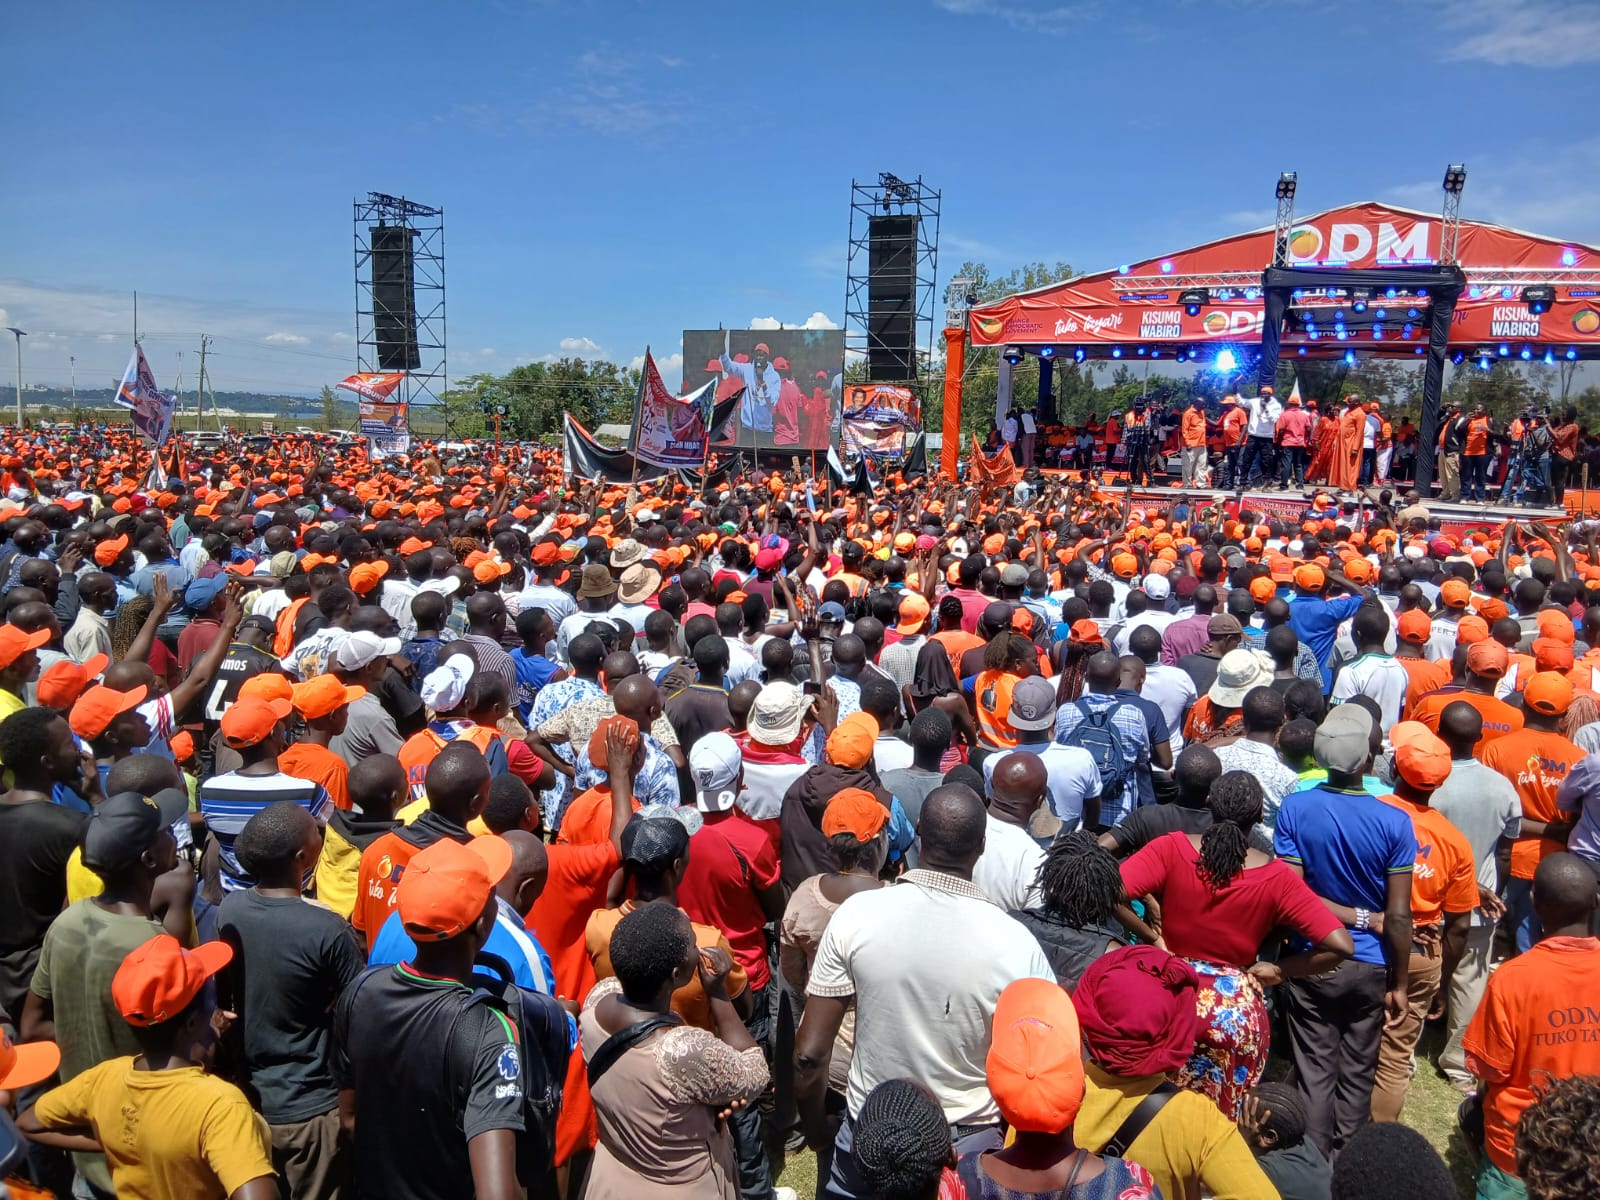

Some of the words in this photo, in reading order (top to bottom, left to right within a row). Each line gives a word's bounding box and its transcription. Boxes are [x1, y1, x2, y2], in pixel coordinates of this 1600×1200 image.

[1142, 310, 1181, 325] KISUMO
[1140, 325, 1180, 338] WABIRO
[1491, 322, 1540, 337] WABIRO
[1483, 721, 1511, 733] ANO
[409, 765, 426, 782] KI
[700, 771, 714, 787] 7
[411, 783, 427, 800] W
[721, 795, 730, 804] 7
[1531, 1030, 1577, 1046] TUKO
